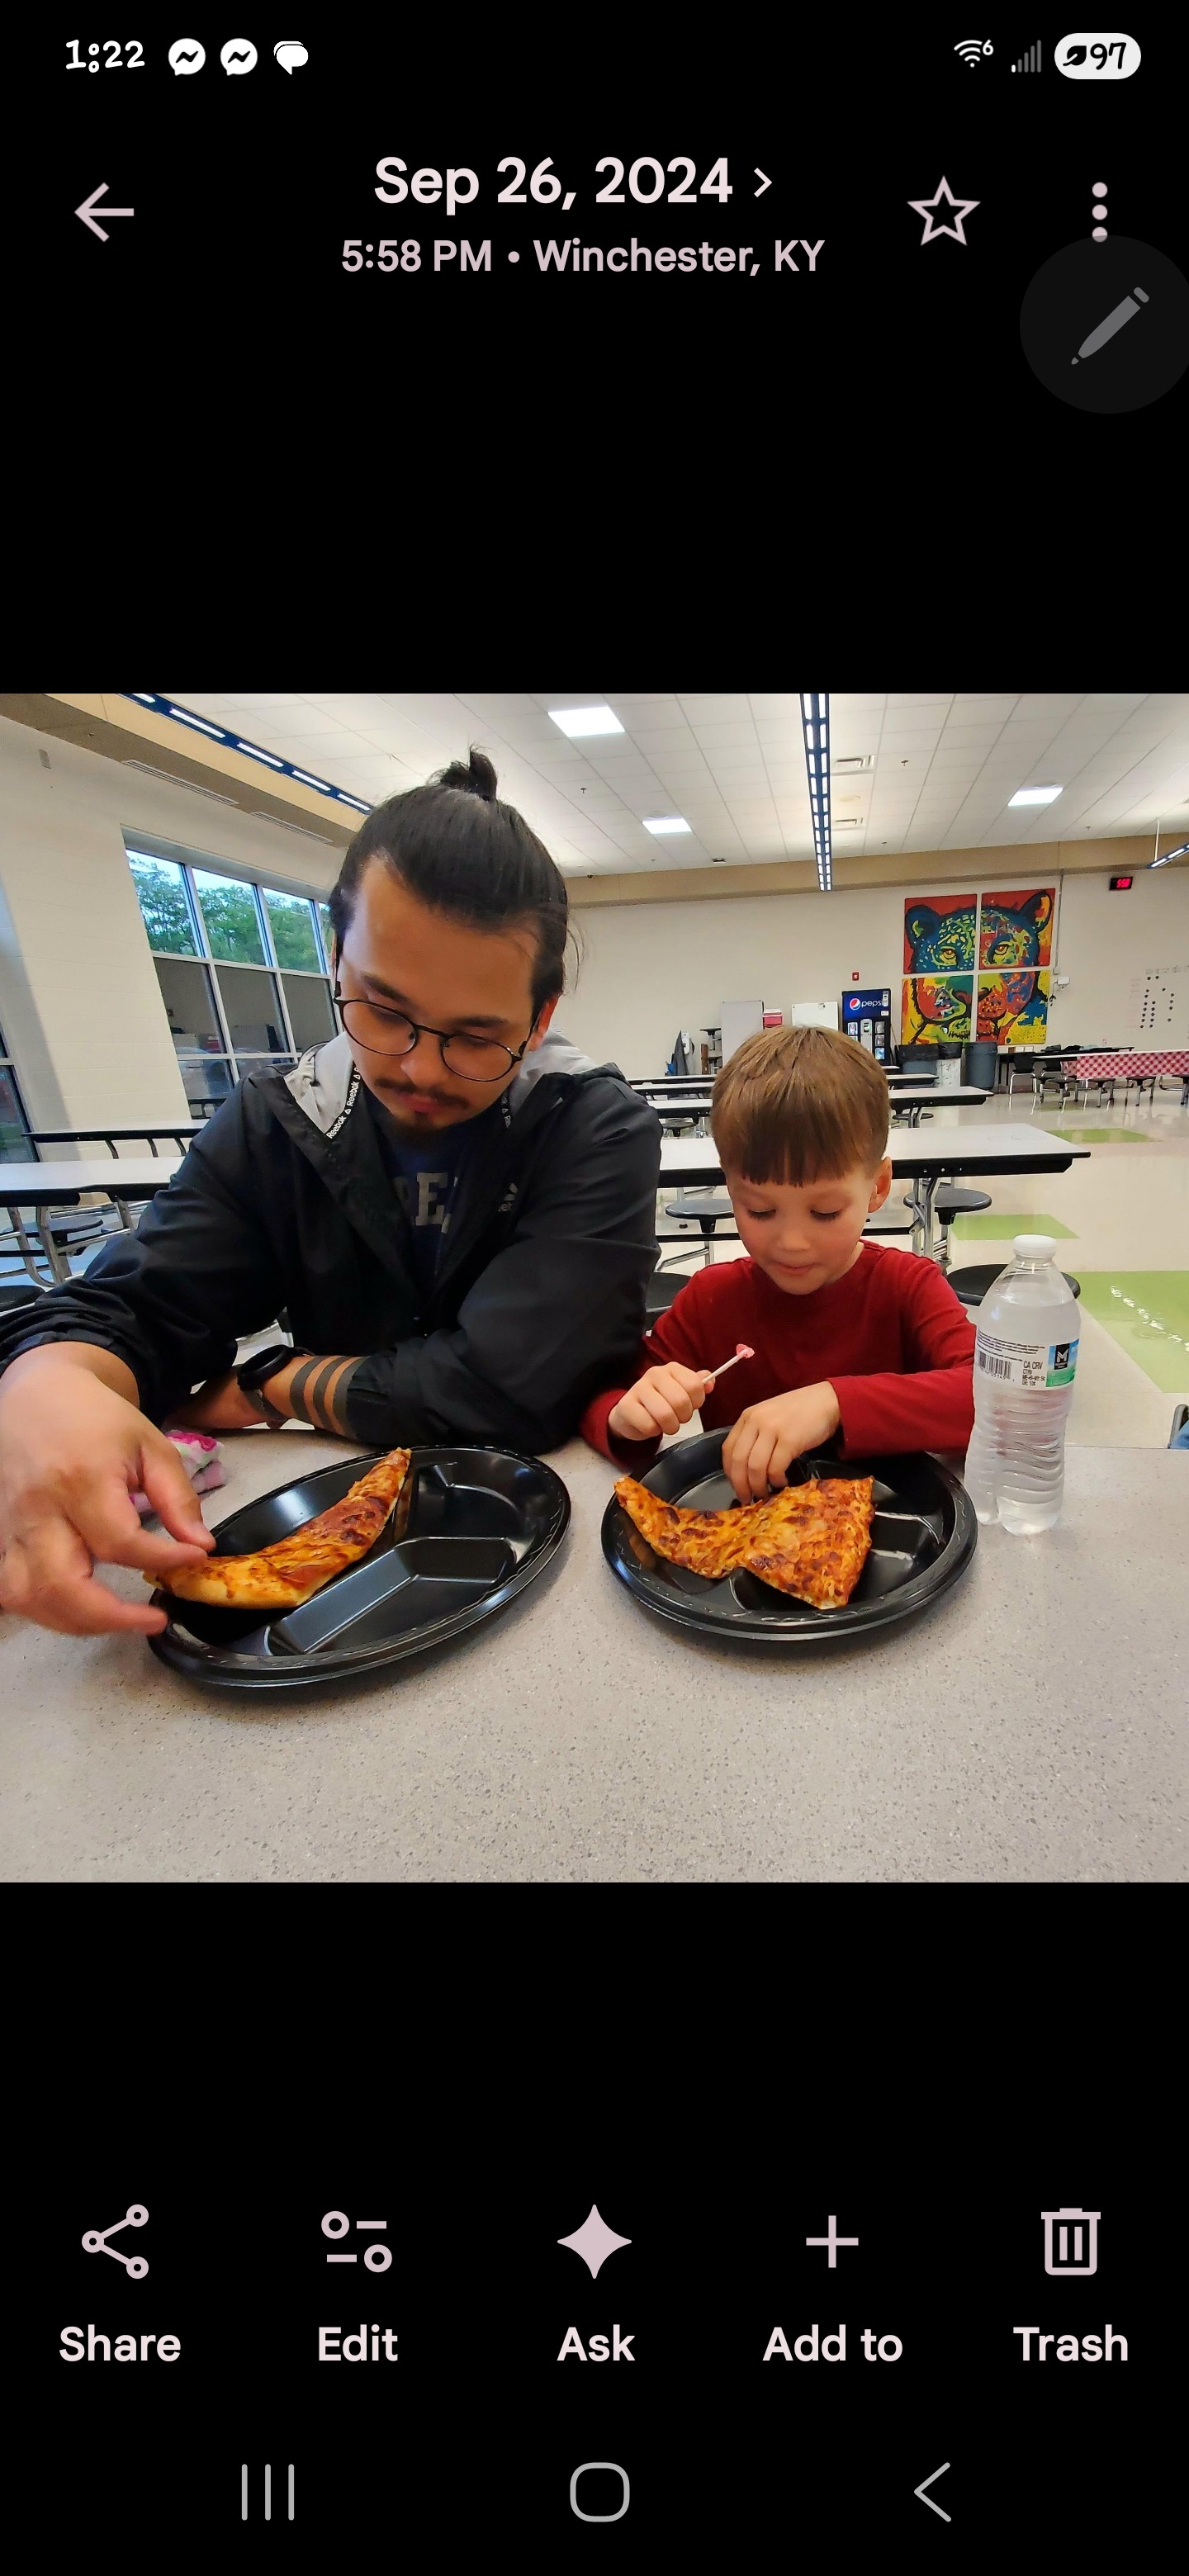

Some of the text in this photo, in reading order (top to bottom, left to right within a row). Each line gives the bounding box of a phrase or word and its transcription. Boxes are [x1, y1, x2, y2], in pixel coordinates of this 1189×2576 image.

[861, 1000, 882, 1008] peps
[325, 1081, 360, 1139] Reebok Reebok
